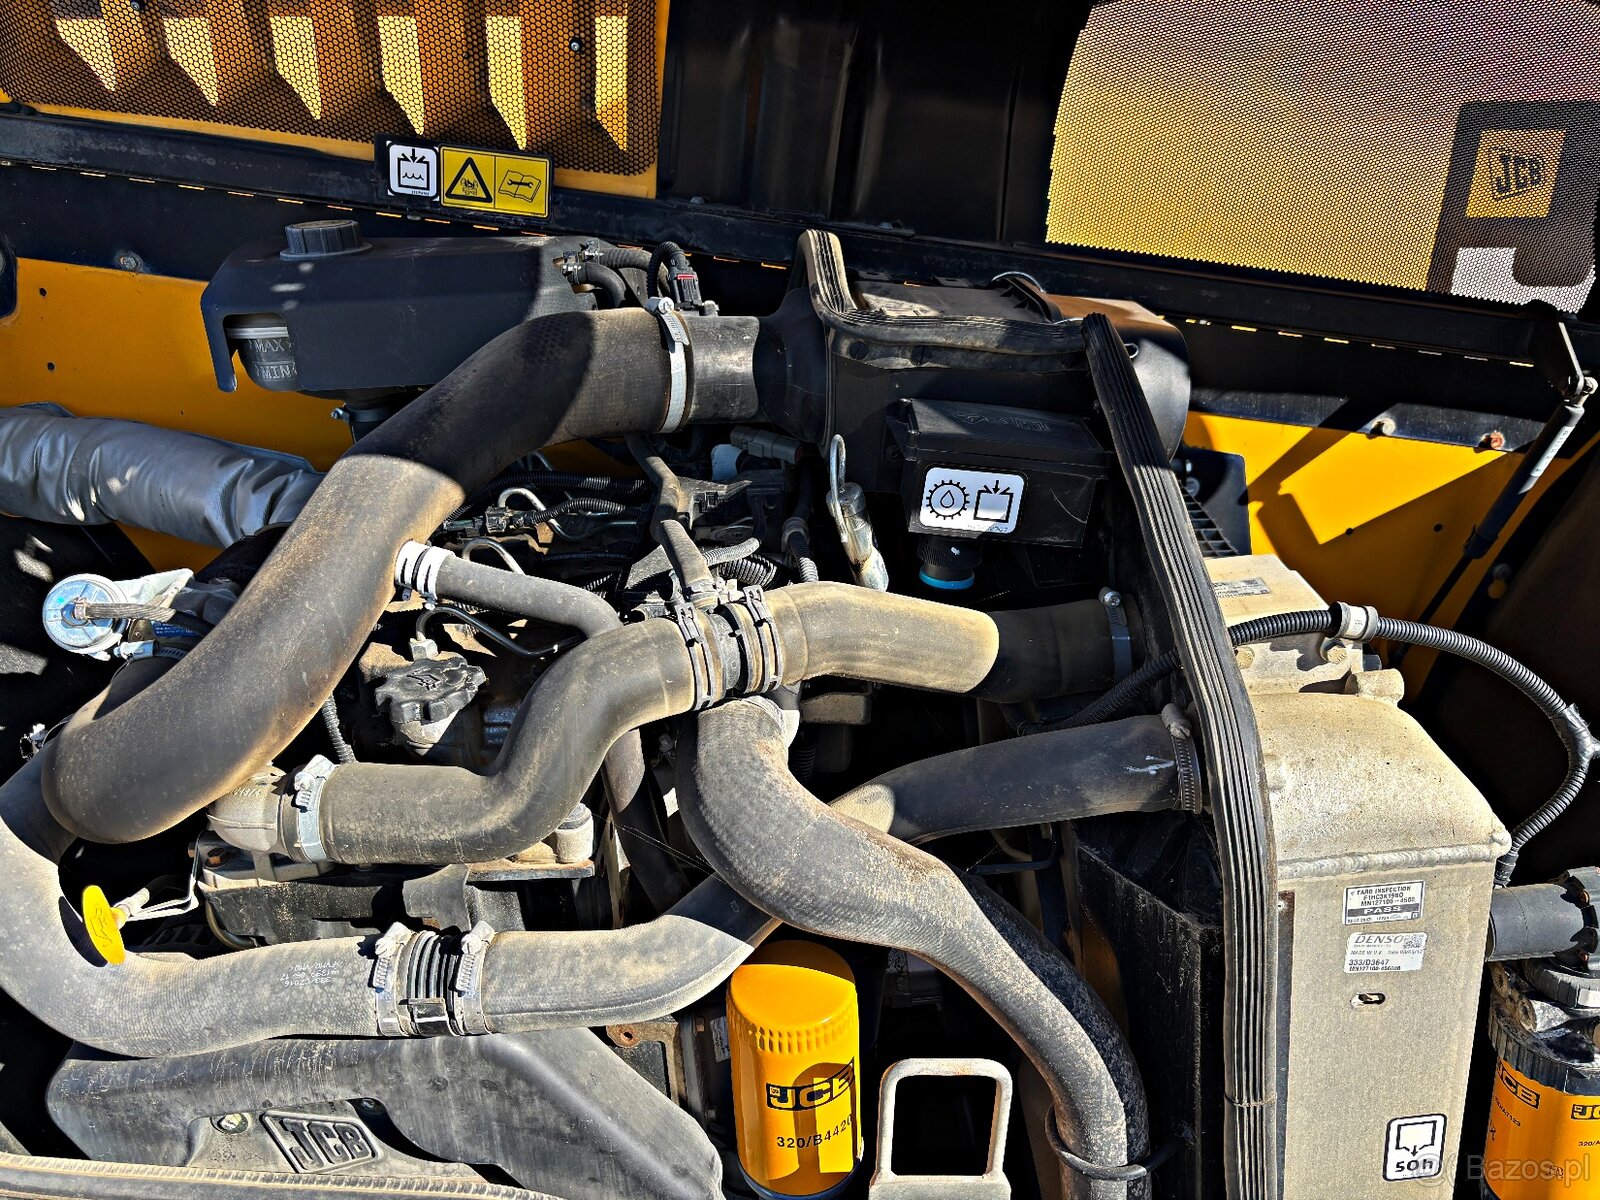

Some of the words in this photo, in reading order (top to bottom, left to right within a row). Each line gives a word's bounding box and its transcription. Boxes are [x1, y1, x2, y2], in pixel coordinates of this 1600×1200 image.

[1495, 152, 1545, 195] JCB
[254, 339, 285, 352] MAX
[261, 364, 292, 379] MIN
[1364, 905, 1402, 915] PASS
[1354, 935, 1404, 944] DENSO
[768, 1060, 854, 1110] JCB
[279, 1118, 371, 1171] JCB
[1395, 1158, 1434, 1173] 50h
